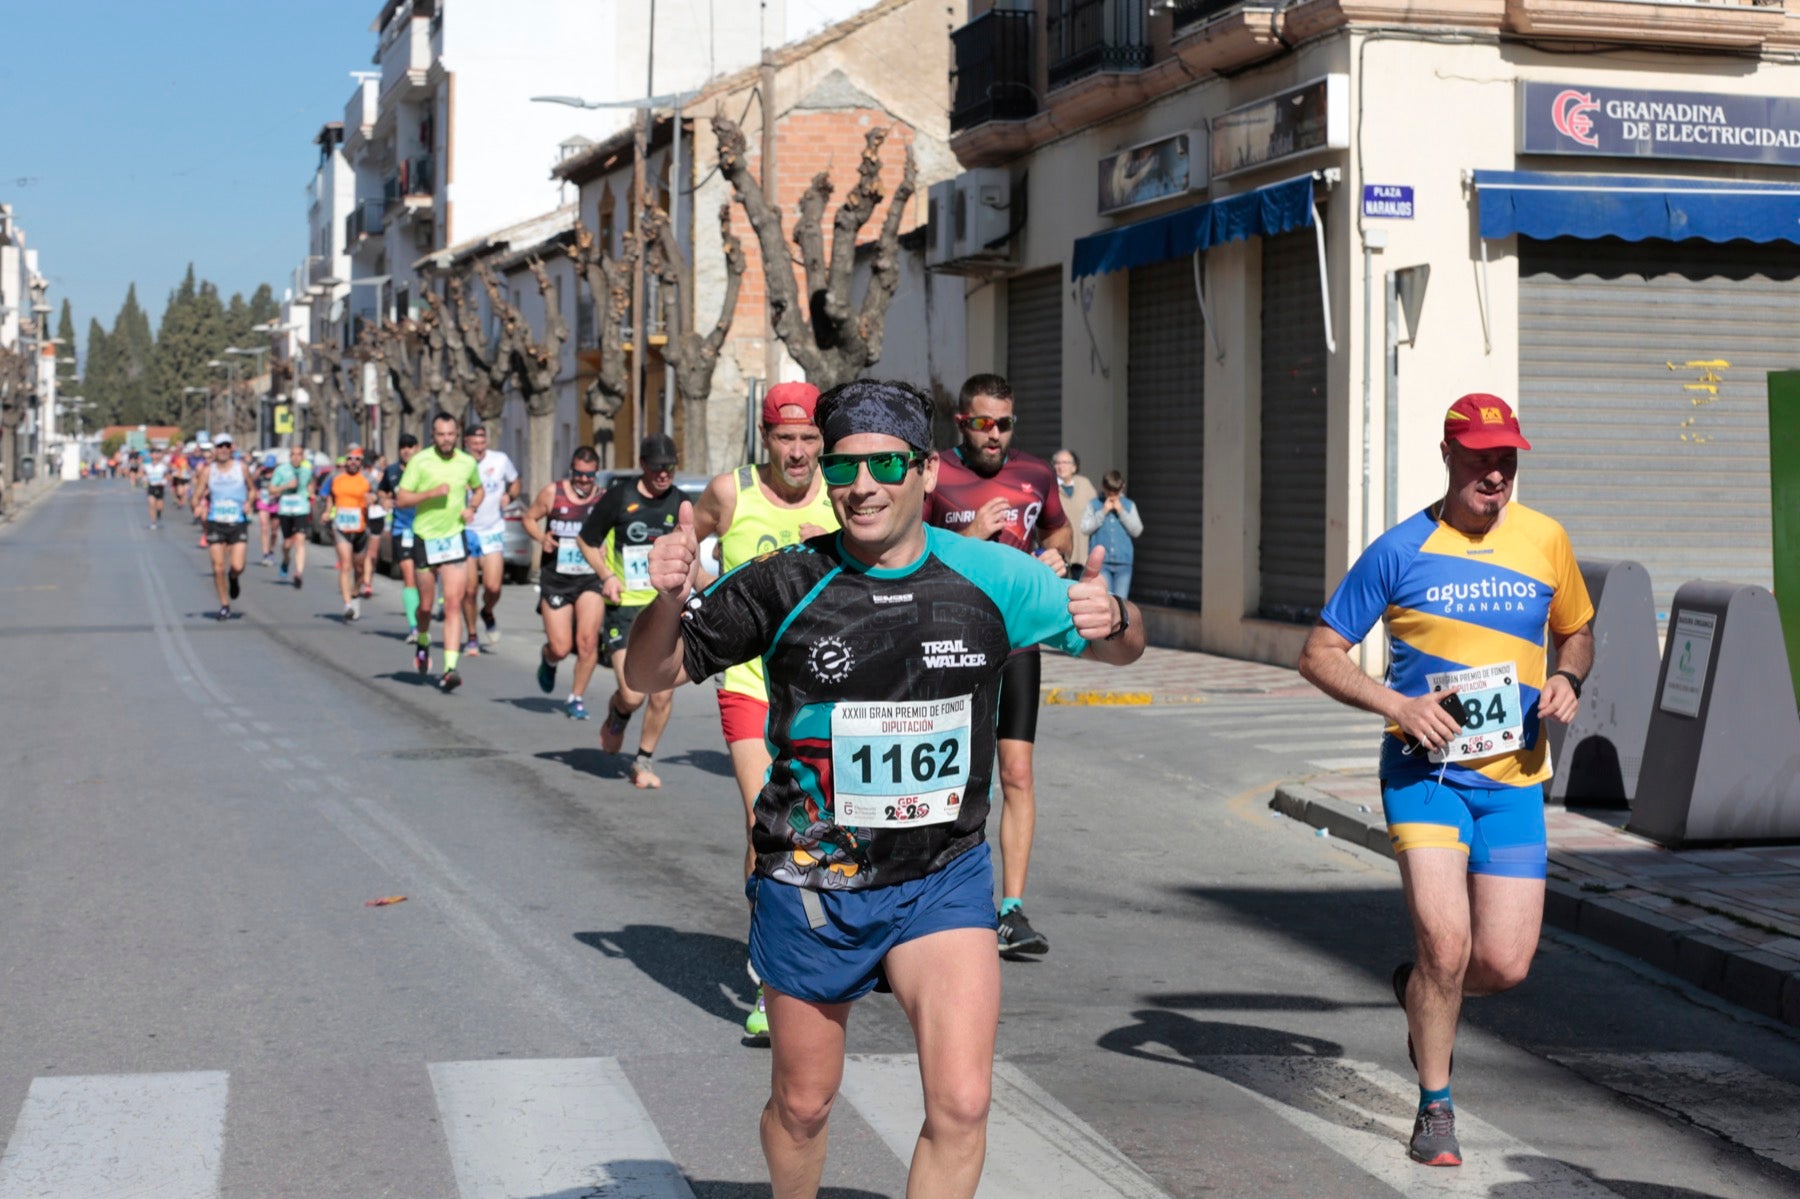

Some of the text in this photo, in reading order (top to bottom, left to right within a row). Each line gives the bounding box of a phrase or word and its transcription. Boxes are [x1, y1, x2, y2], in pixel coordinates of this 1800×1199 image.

[1606, 100, 1726, 124] GRANADINA
[1622, 121, 1800, 148] DE ELECTRICIDAD
[1373, 186, 1402, 198] PLAZA
[1365, 200, 1412, 216] NARANJOS
[1426, 576, 1537, 607] agustinos
[1444, 601, 1525, 613] GRANADA
[921, 639, 968, 654] TRAIL
[922, 653, 987, 669] WALKER
[1459, 671, 1482, 682] PREMIO
[1482, 669, 1490, 678] DE
[1490, 665, 1511, 676] FONDO
[842, 700, 965, 719] XXXIII GRAN PREMIO DE FONDO
[881, 719, 934, 733] DIPUTACIÓN
[852, 738, 960, 784] 1162
